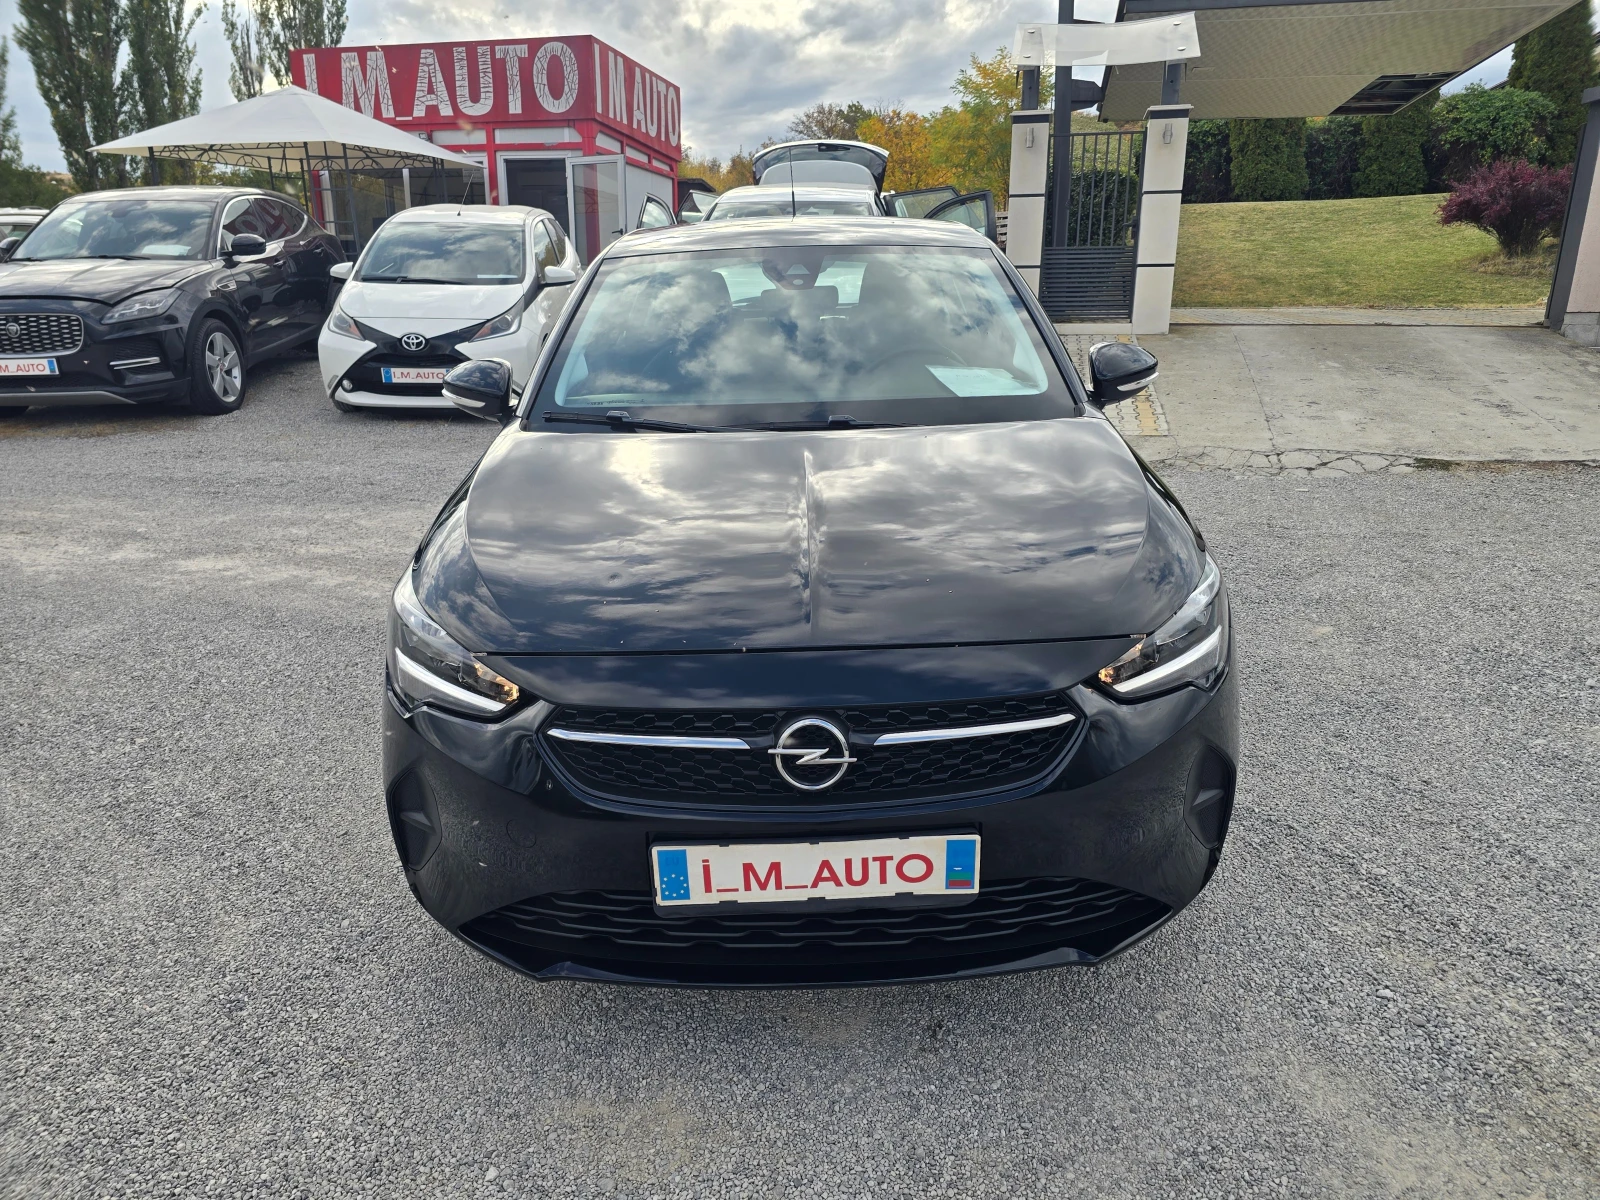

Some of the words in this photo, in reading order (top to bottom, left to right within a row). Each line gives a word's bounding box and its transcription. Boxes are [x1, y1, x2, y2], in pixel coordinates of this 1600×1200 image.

[594, 43, 602, 114] I
[608, 51, 628, 125] M
[633, 67, 679, 147] AUTO
